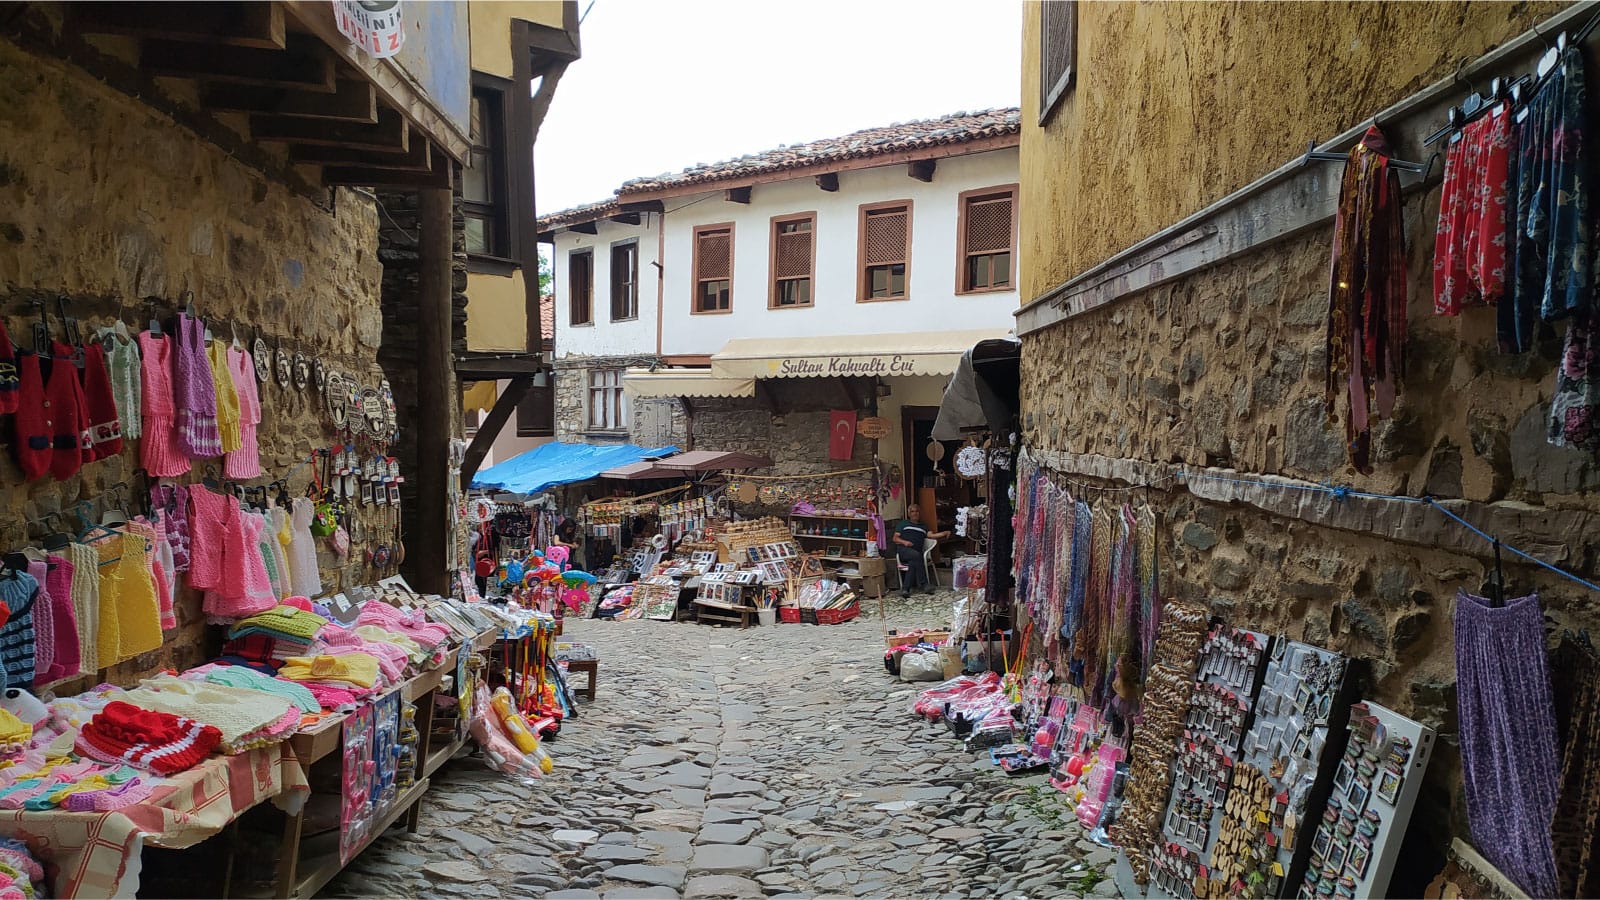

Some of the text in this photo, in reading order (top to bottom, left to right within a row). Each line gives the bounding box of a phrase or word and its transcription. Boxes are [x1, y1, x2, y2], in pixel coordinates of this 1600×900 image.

[781, 355, 915, 374] Sultan Kahvaltı Evi
